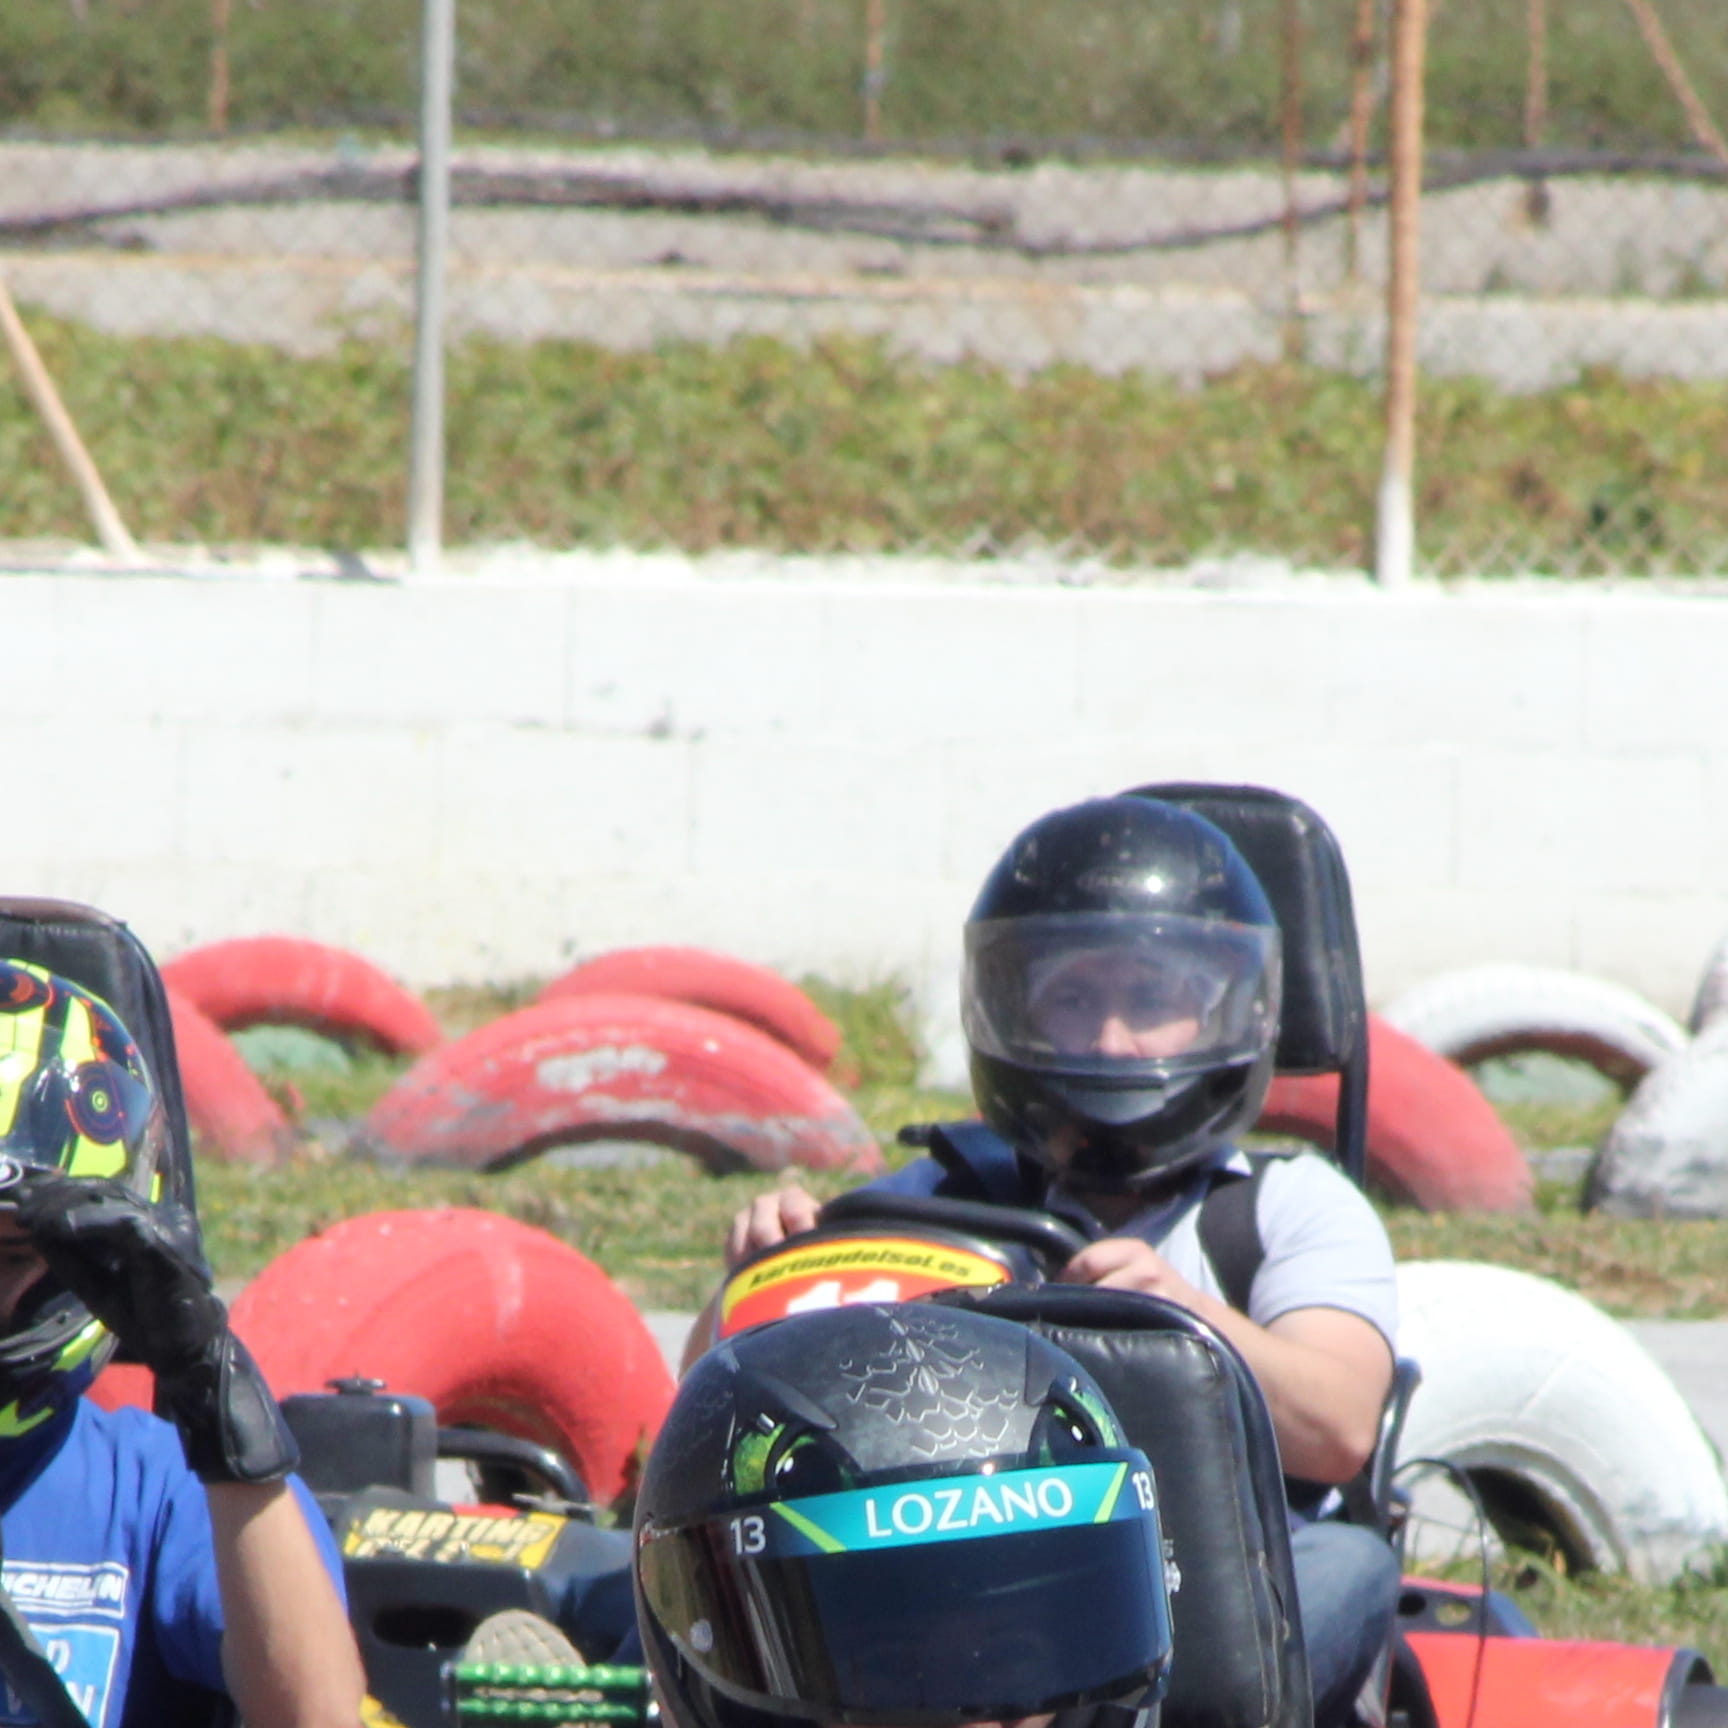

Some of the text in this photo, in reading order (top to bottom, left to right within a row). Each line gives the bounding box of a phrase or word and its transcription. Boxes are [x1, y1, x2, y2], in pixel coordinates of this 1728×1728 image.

[363, 1507, 557, 1545] KARTING
[730, 1471, 1155, 1556] 13 LOZANO 13
